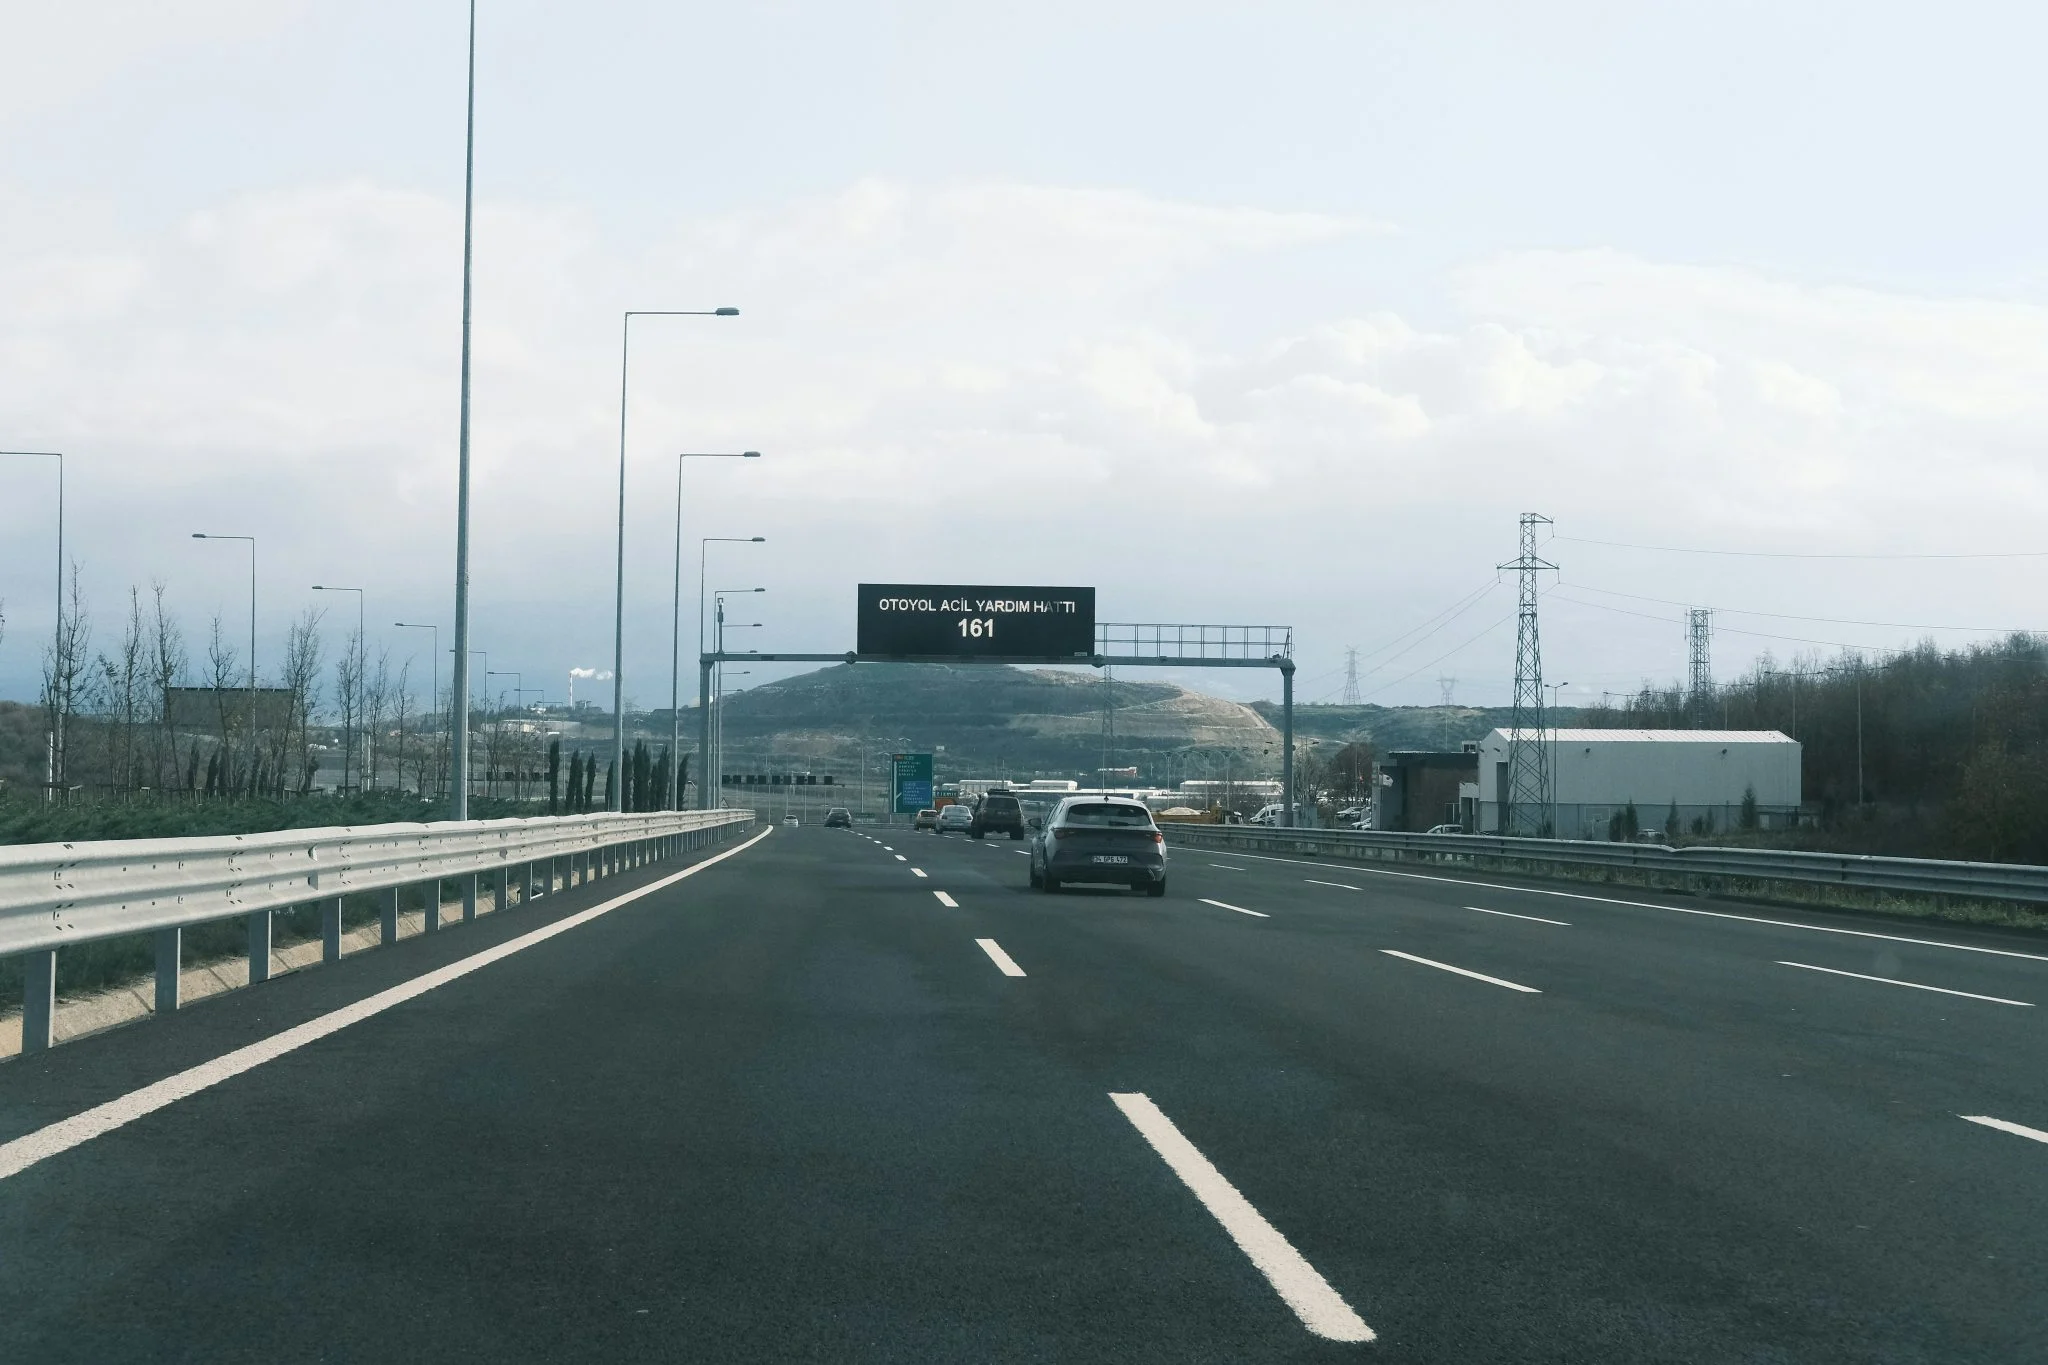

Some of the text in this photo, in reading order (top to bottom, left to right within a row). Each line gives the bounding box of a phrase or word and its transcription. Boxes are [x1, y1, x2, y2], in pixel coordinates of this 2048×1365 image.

[878, 596, 1076, 614] OTOYOL ACİL YARDIM HATTI
[957, 617, 994, 638] 161
